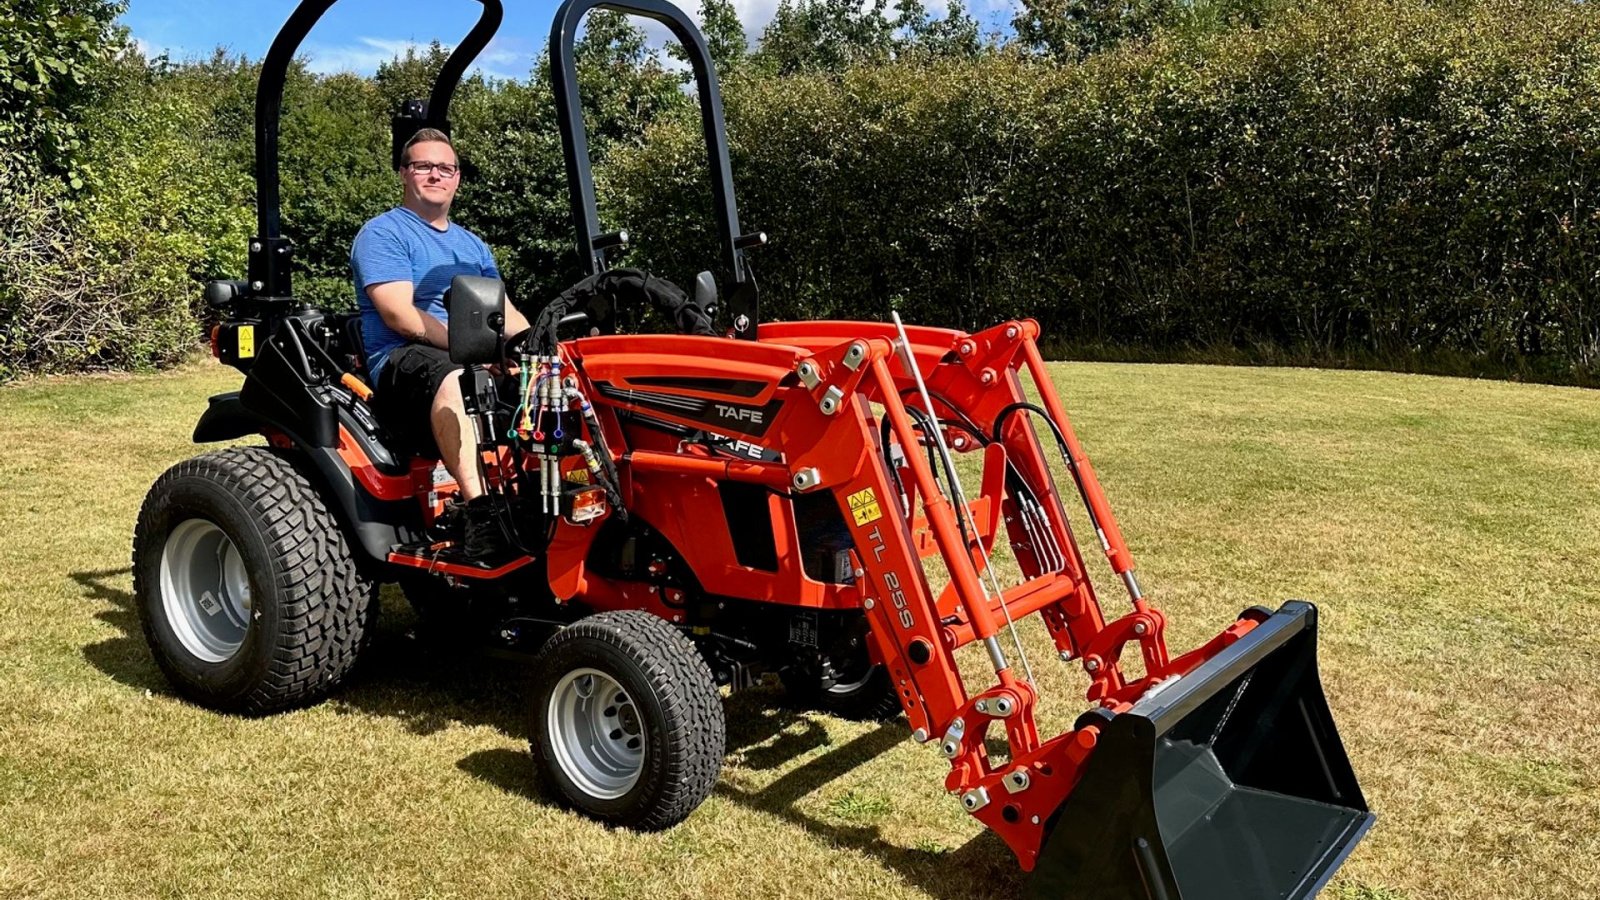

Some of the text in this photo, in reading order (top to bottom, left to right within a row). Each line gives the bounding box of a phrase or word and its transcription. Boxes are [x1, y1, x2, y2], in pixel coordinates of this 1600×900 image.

[715, 404, 763, 424] TAFE
[865, 525, 915, 629] TL 25S
